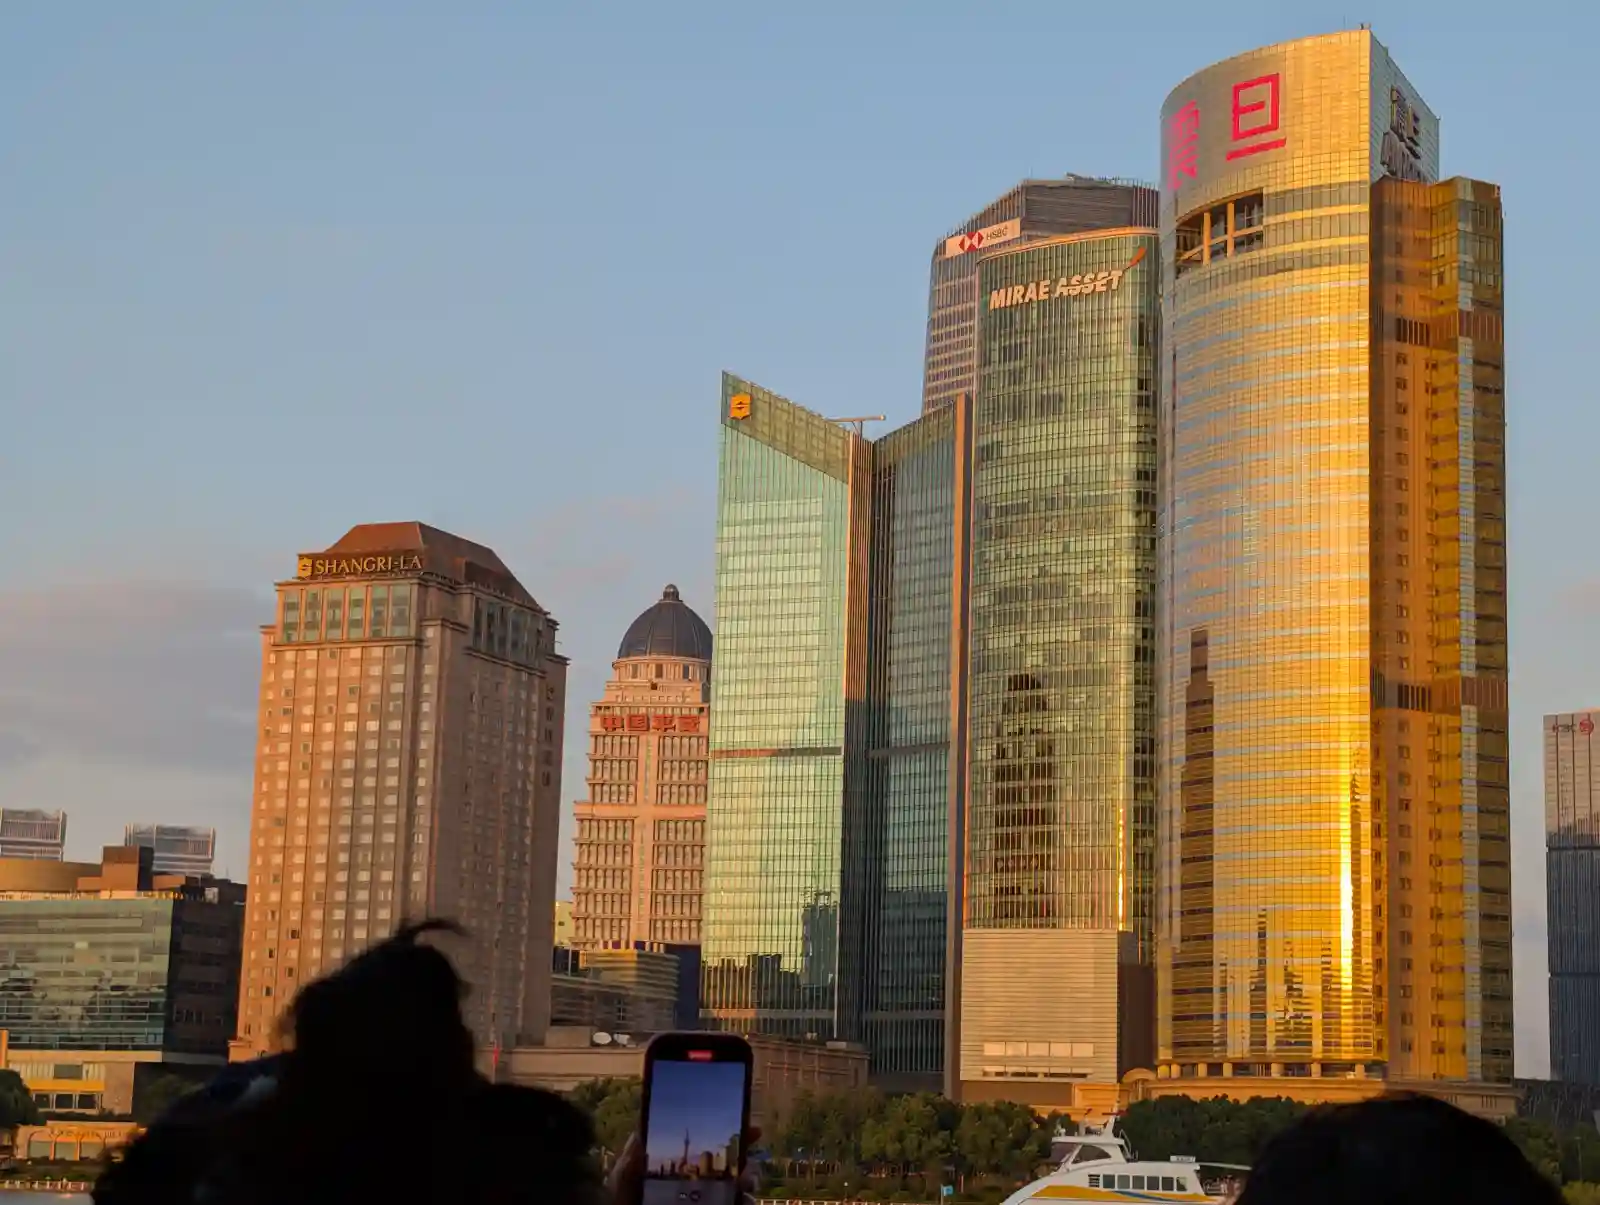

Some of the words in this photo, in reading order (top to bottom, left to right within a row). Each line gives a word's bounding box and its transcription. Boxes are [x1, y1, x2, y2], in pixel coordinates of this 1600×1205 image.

[986, 225, 1008, 241] HSBC
[989, 280, 1050, 310] MIRAE
[1054, 270, 1123, 297] ASSET
[315, 555, 422, 575] SHANGRI-LA
